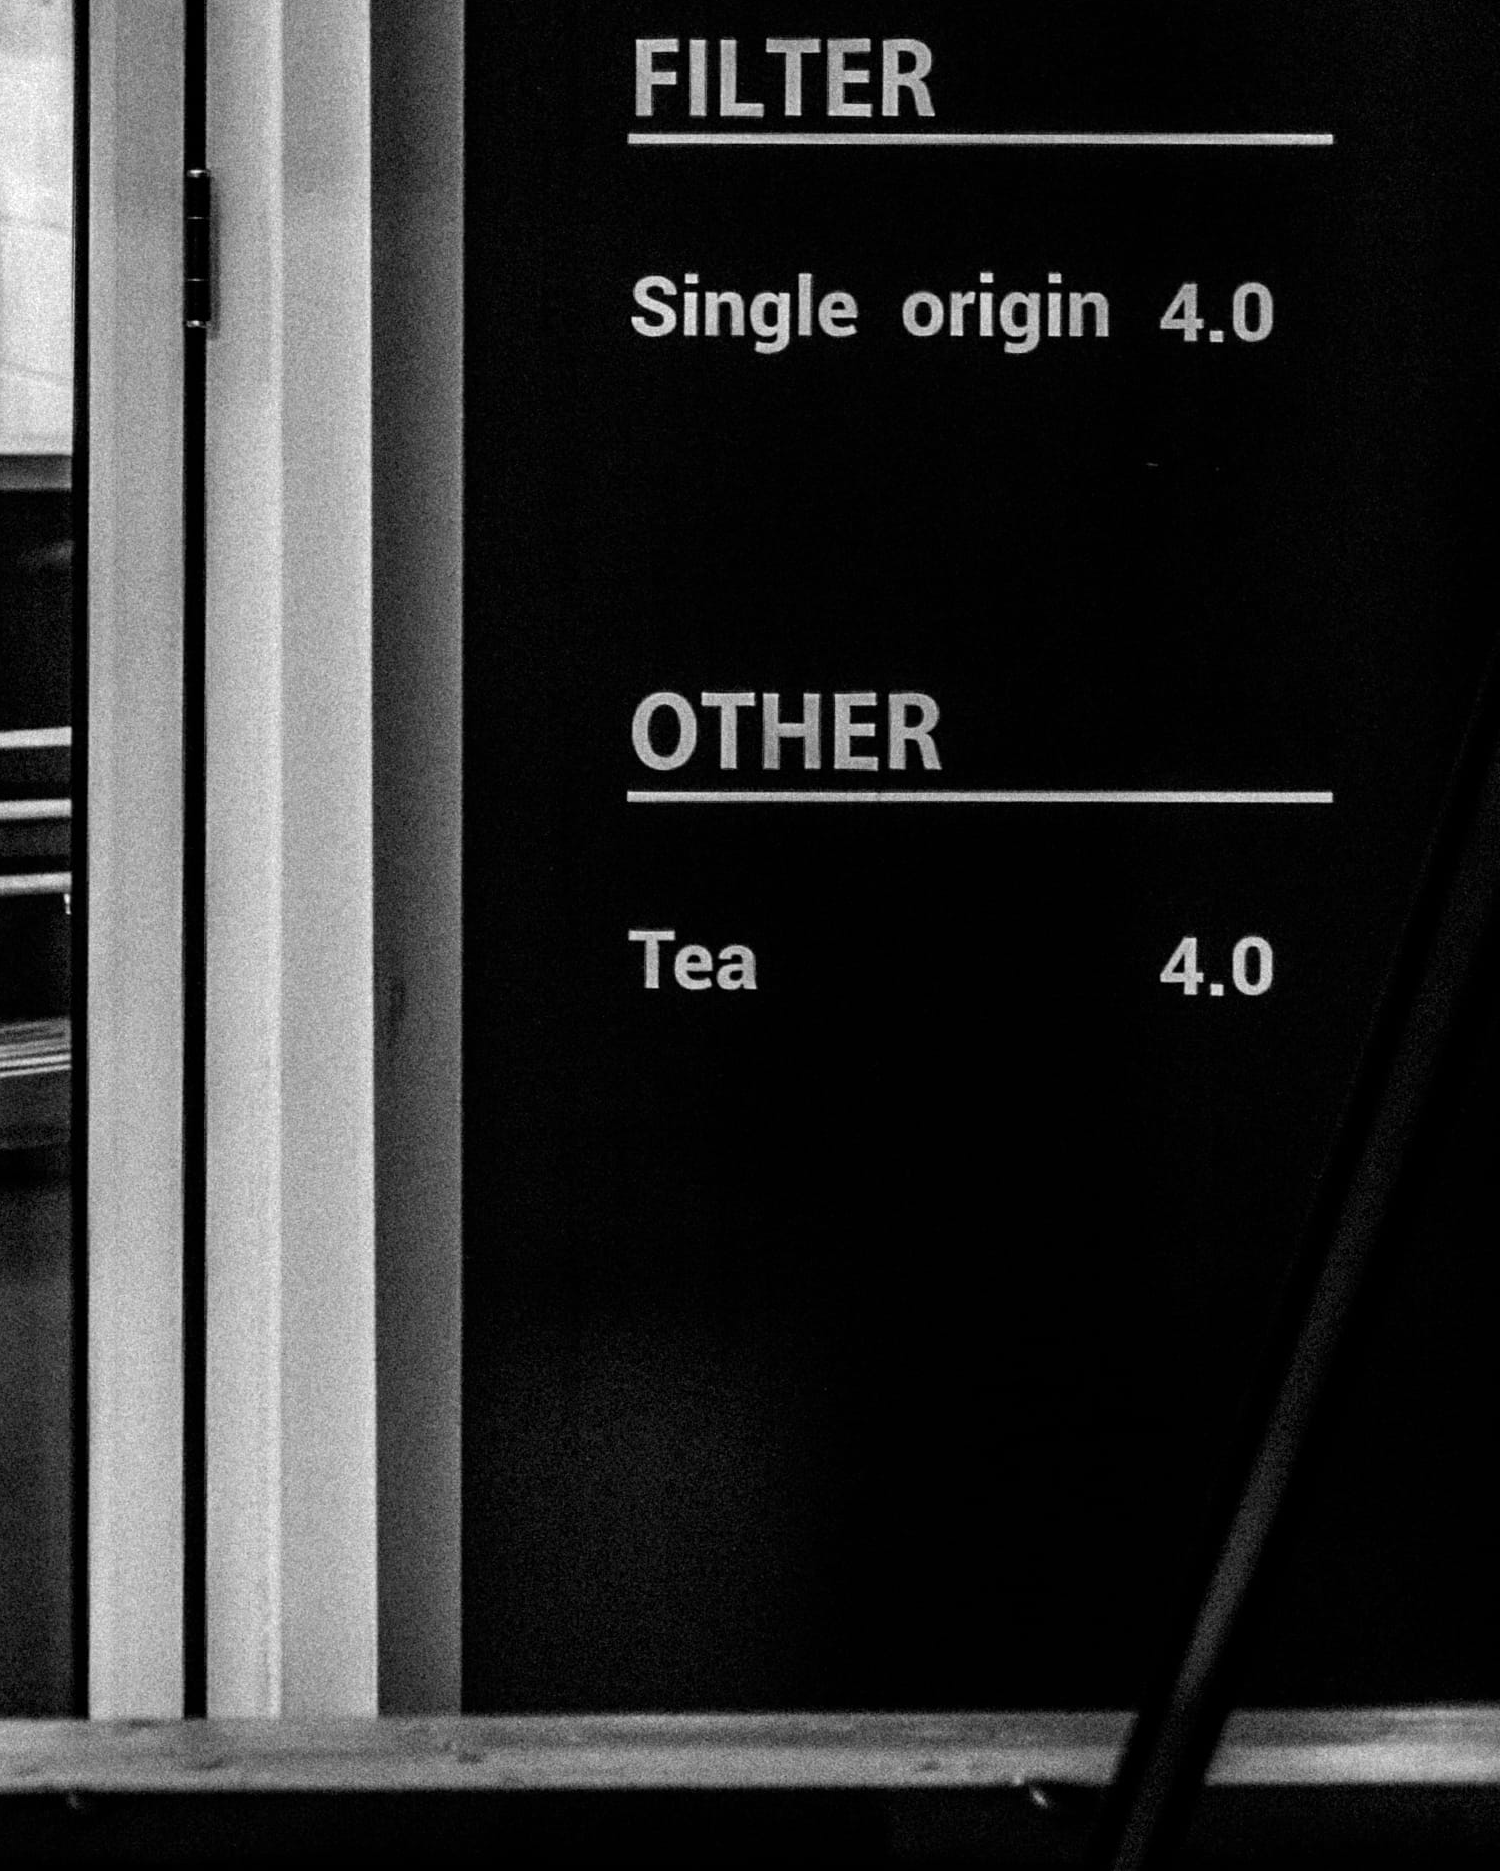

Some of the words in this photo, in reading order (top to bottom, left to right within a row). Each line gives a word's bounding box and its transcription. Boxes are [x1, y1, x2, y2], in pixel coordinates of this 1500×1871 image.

[636, 38, 935, 117] FILTER
[631, 273, 858, 354] Single
[903, 272, 1108, 353] origin
[1160, 283, 1273, 342] 4.0
[632, 692, 941, 771] OTHER
[628, 930, 757, 990] Tea
[1160, 936, 1273, 996] 4.0
